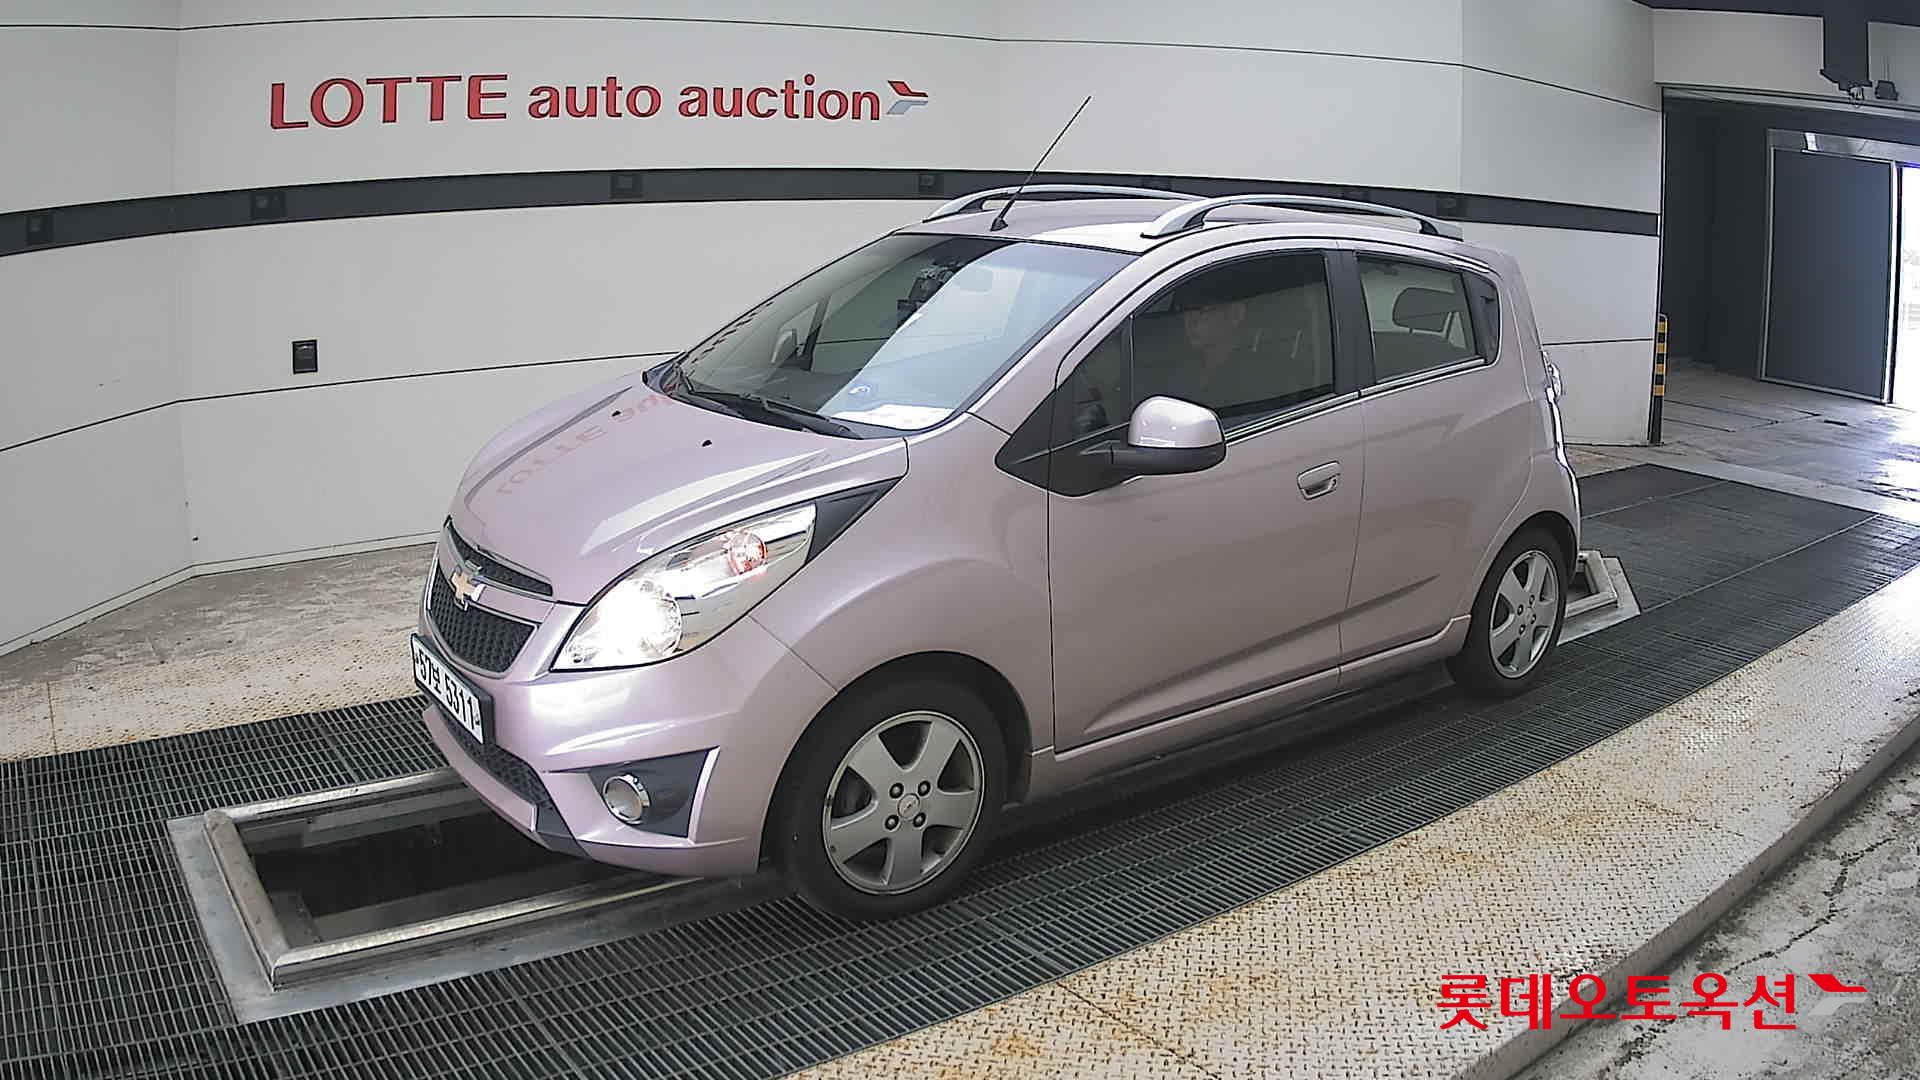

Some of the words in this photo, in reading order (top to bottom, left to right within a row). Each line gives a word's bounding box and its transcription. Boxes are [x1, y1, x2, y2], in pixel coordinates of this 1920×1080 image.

[269, 74, 508, 130] LOTTE
[527, 75, 662, 119] auto
[677, 73, 881, 121] auction
[444, 673, 475, 731] 5311
